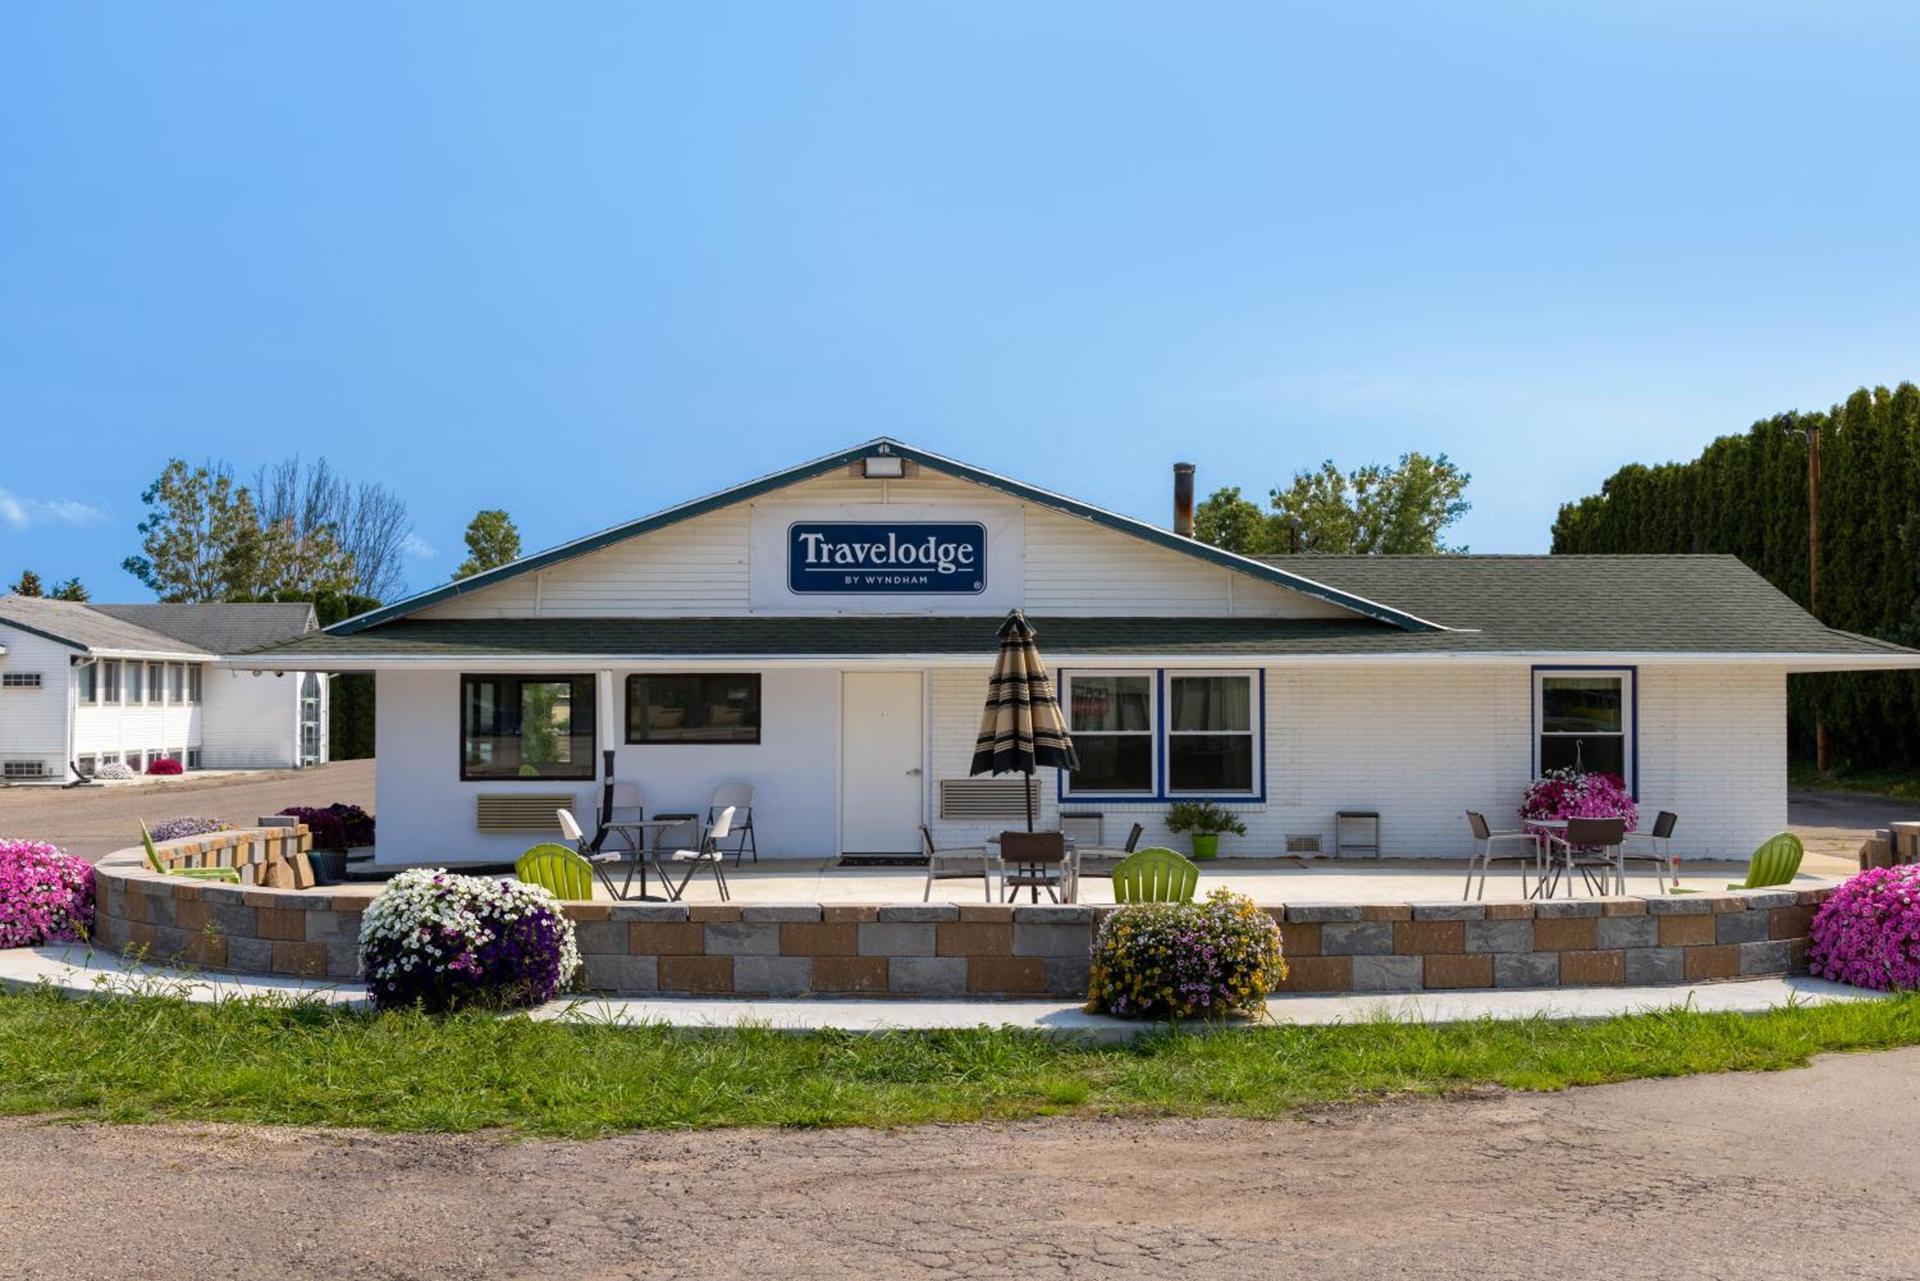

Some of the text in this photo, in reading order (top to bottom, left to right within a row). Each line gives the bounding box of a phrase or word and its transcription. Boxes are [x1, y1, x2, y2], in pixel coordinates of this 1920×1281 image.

[799, 532, 974, 574] Travelodge
[845, 576, 928, 584] BY WYNDHAM
